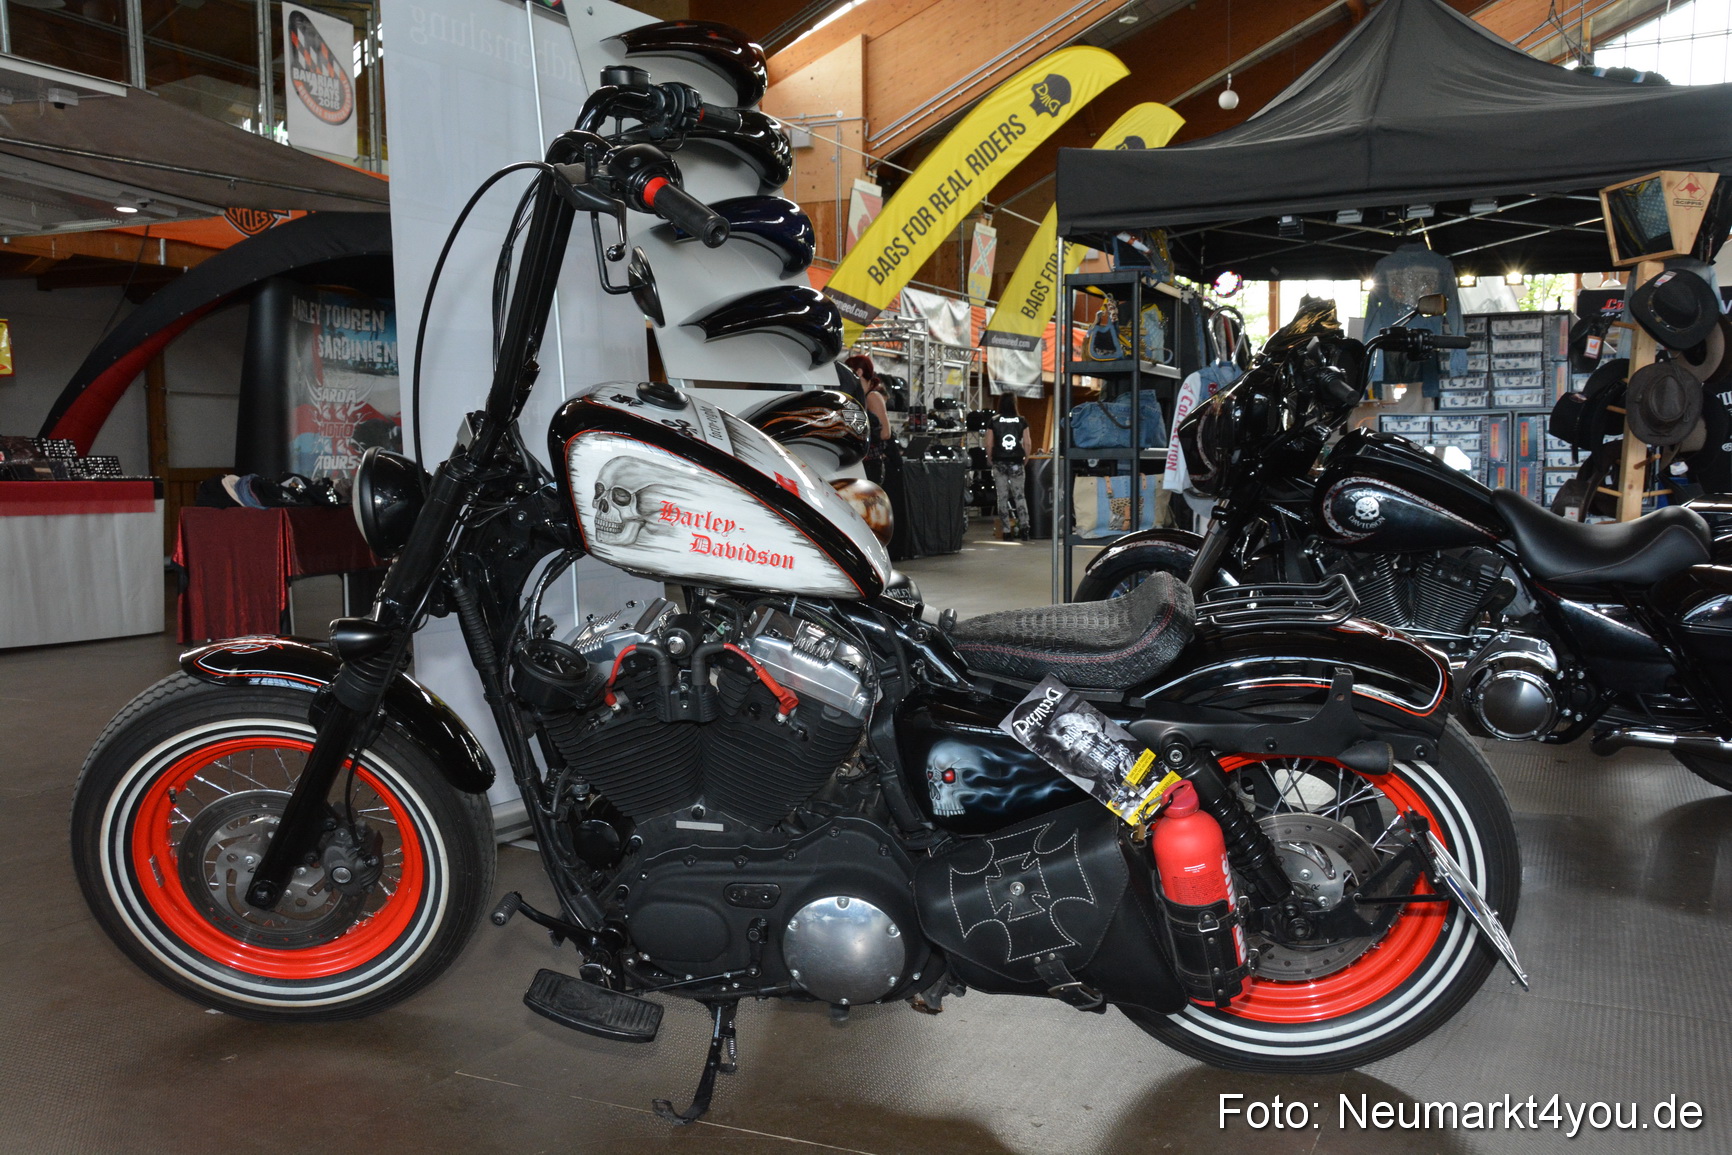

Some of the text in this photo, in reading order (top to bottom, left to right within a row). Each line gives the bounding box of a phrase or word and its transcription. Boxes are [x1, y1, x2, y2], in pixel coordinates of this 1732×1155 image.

[292, 67, 340, 91] BAVARIAN
[318, 97, 340, 110] 2018
[867, 113, 1027, 286] BAGS FOR REAL RIDERS
[1021, 280, 1050, 320] BAGS
[324, 304, 385, 332] TOUREN
[318, 335, 398, 364] SARDINIEN
[658, 500, 745, 537] Harley-
[689, 533, 796, 570] Davidson
[1088, 741, 1112, 763] REAL
